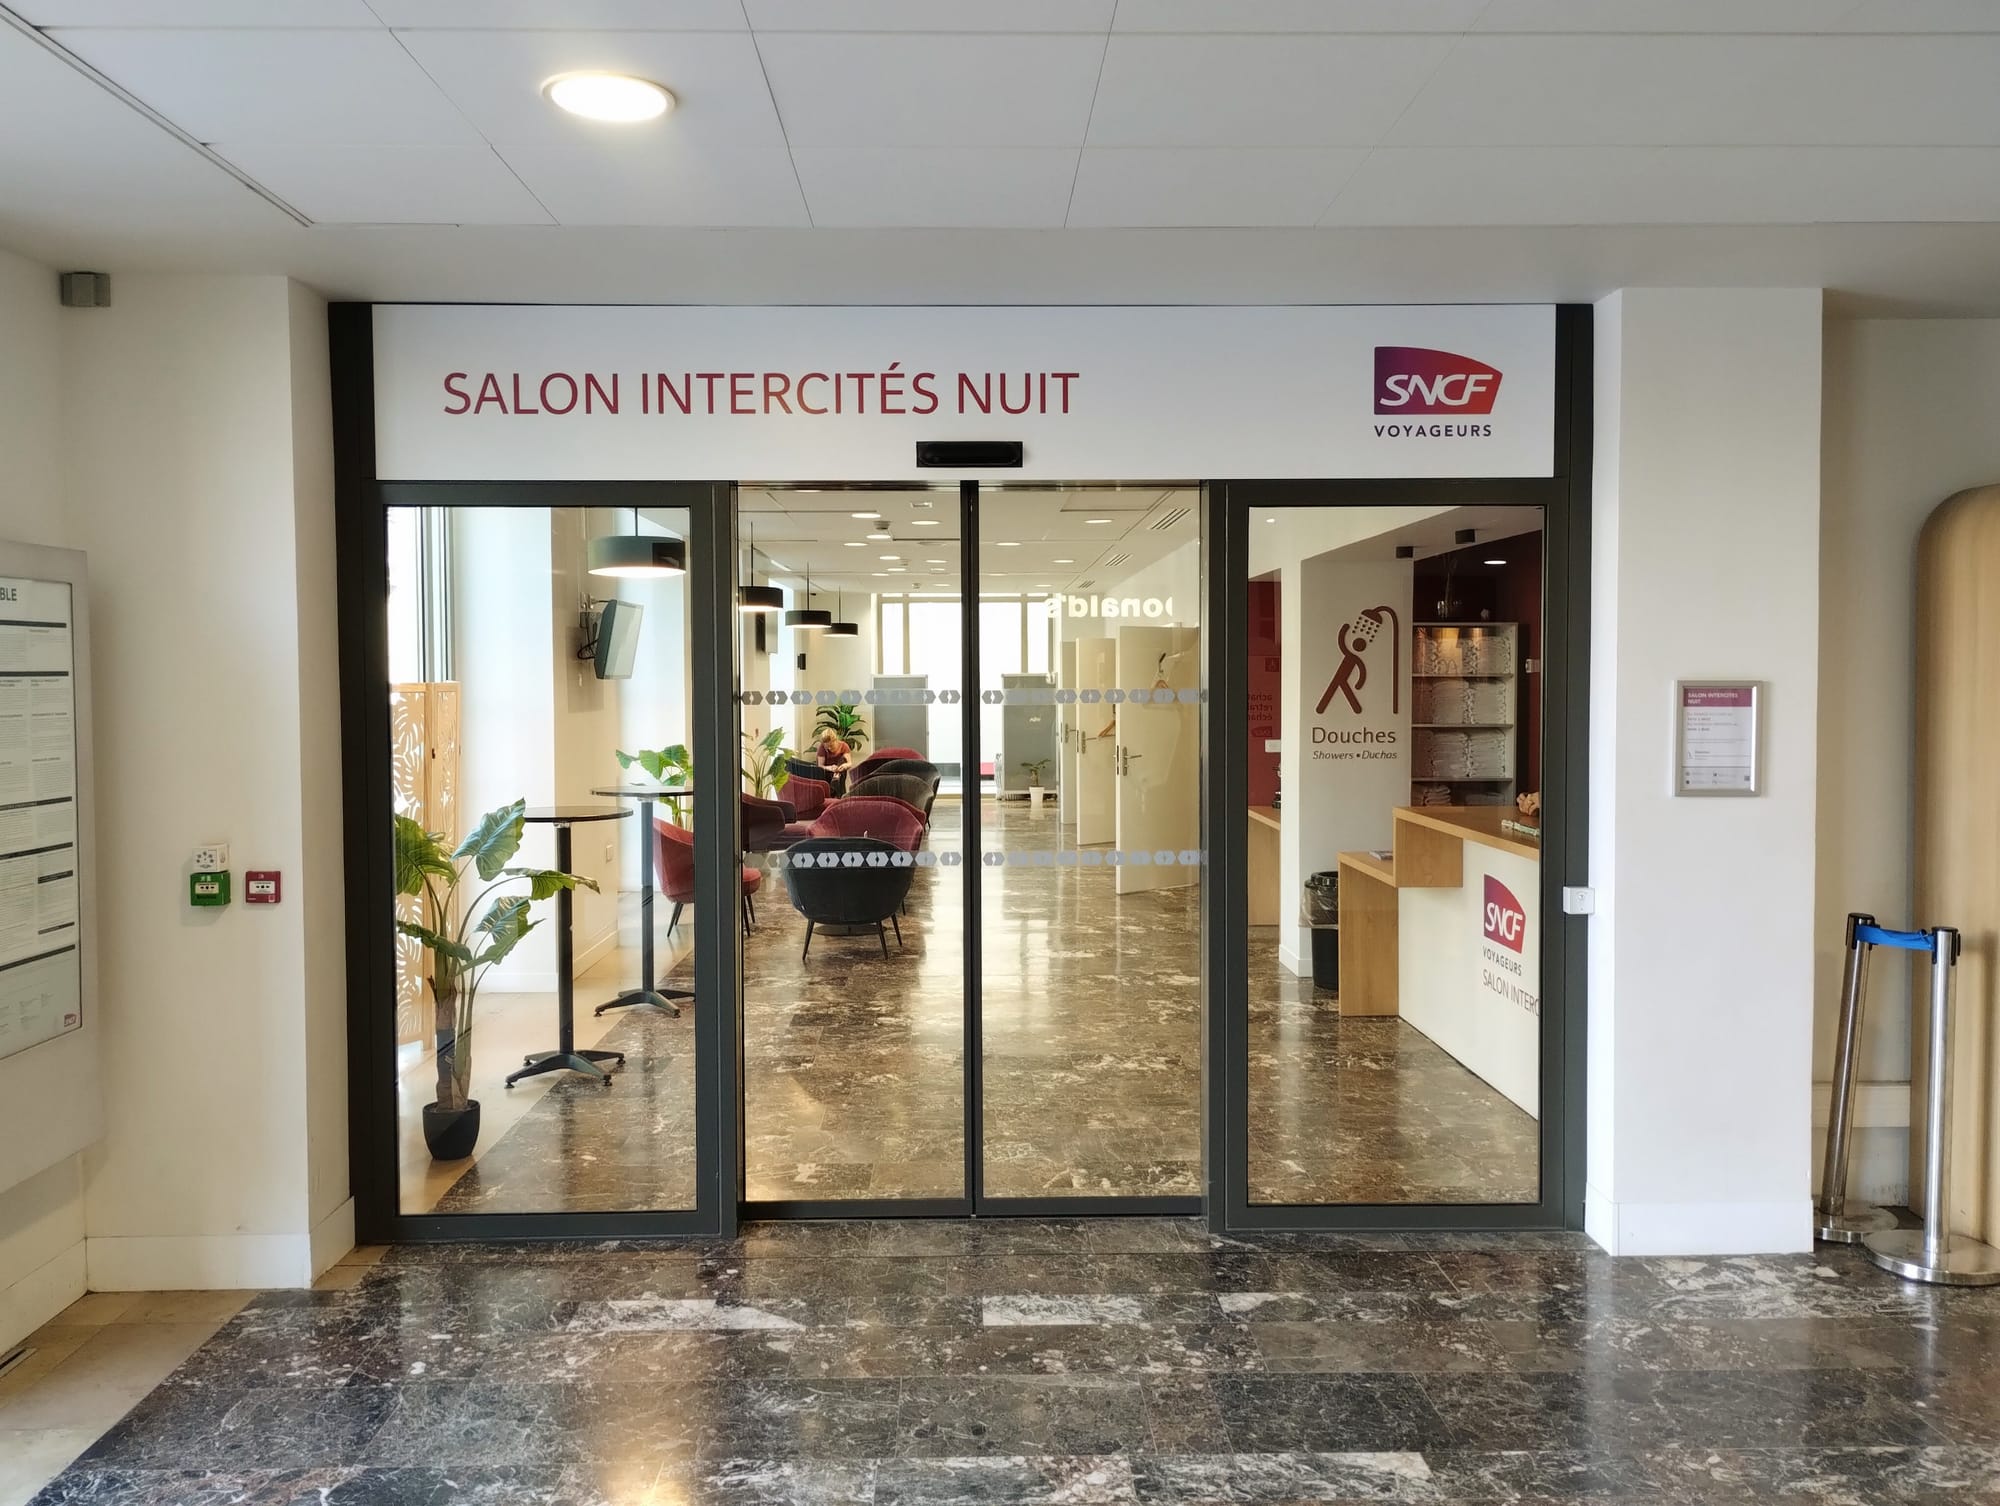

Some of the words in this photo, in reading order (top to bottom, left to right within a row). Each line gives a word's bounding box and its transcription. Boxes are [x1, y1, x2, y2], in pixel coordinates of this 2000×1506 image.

[443, 372, 619, 415] SALON
[641, 361, 939, 415] INTERCITÉS
[957, 372, 1080, 415] NUIT
[1379, 373, 1494, 406] SNCF
[1374, 424, 1492, 438] VOYAGEURS
[1311, 727, 1397, 744] Douches
[1312, 750, 1354, 760] Showers
[1485, 902, 1523, 941] SNCF
[1483, 946, 1522, 976] VOYAGEURS
[1483, 969, 1509, 998] SALON
